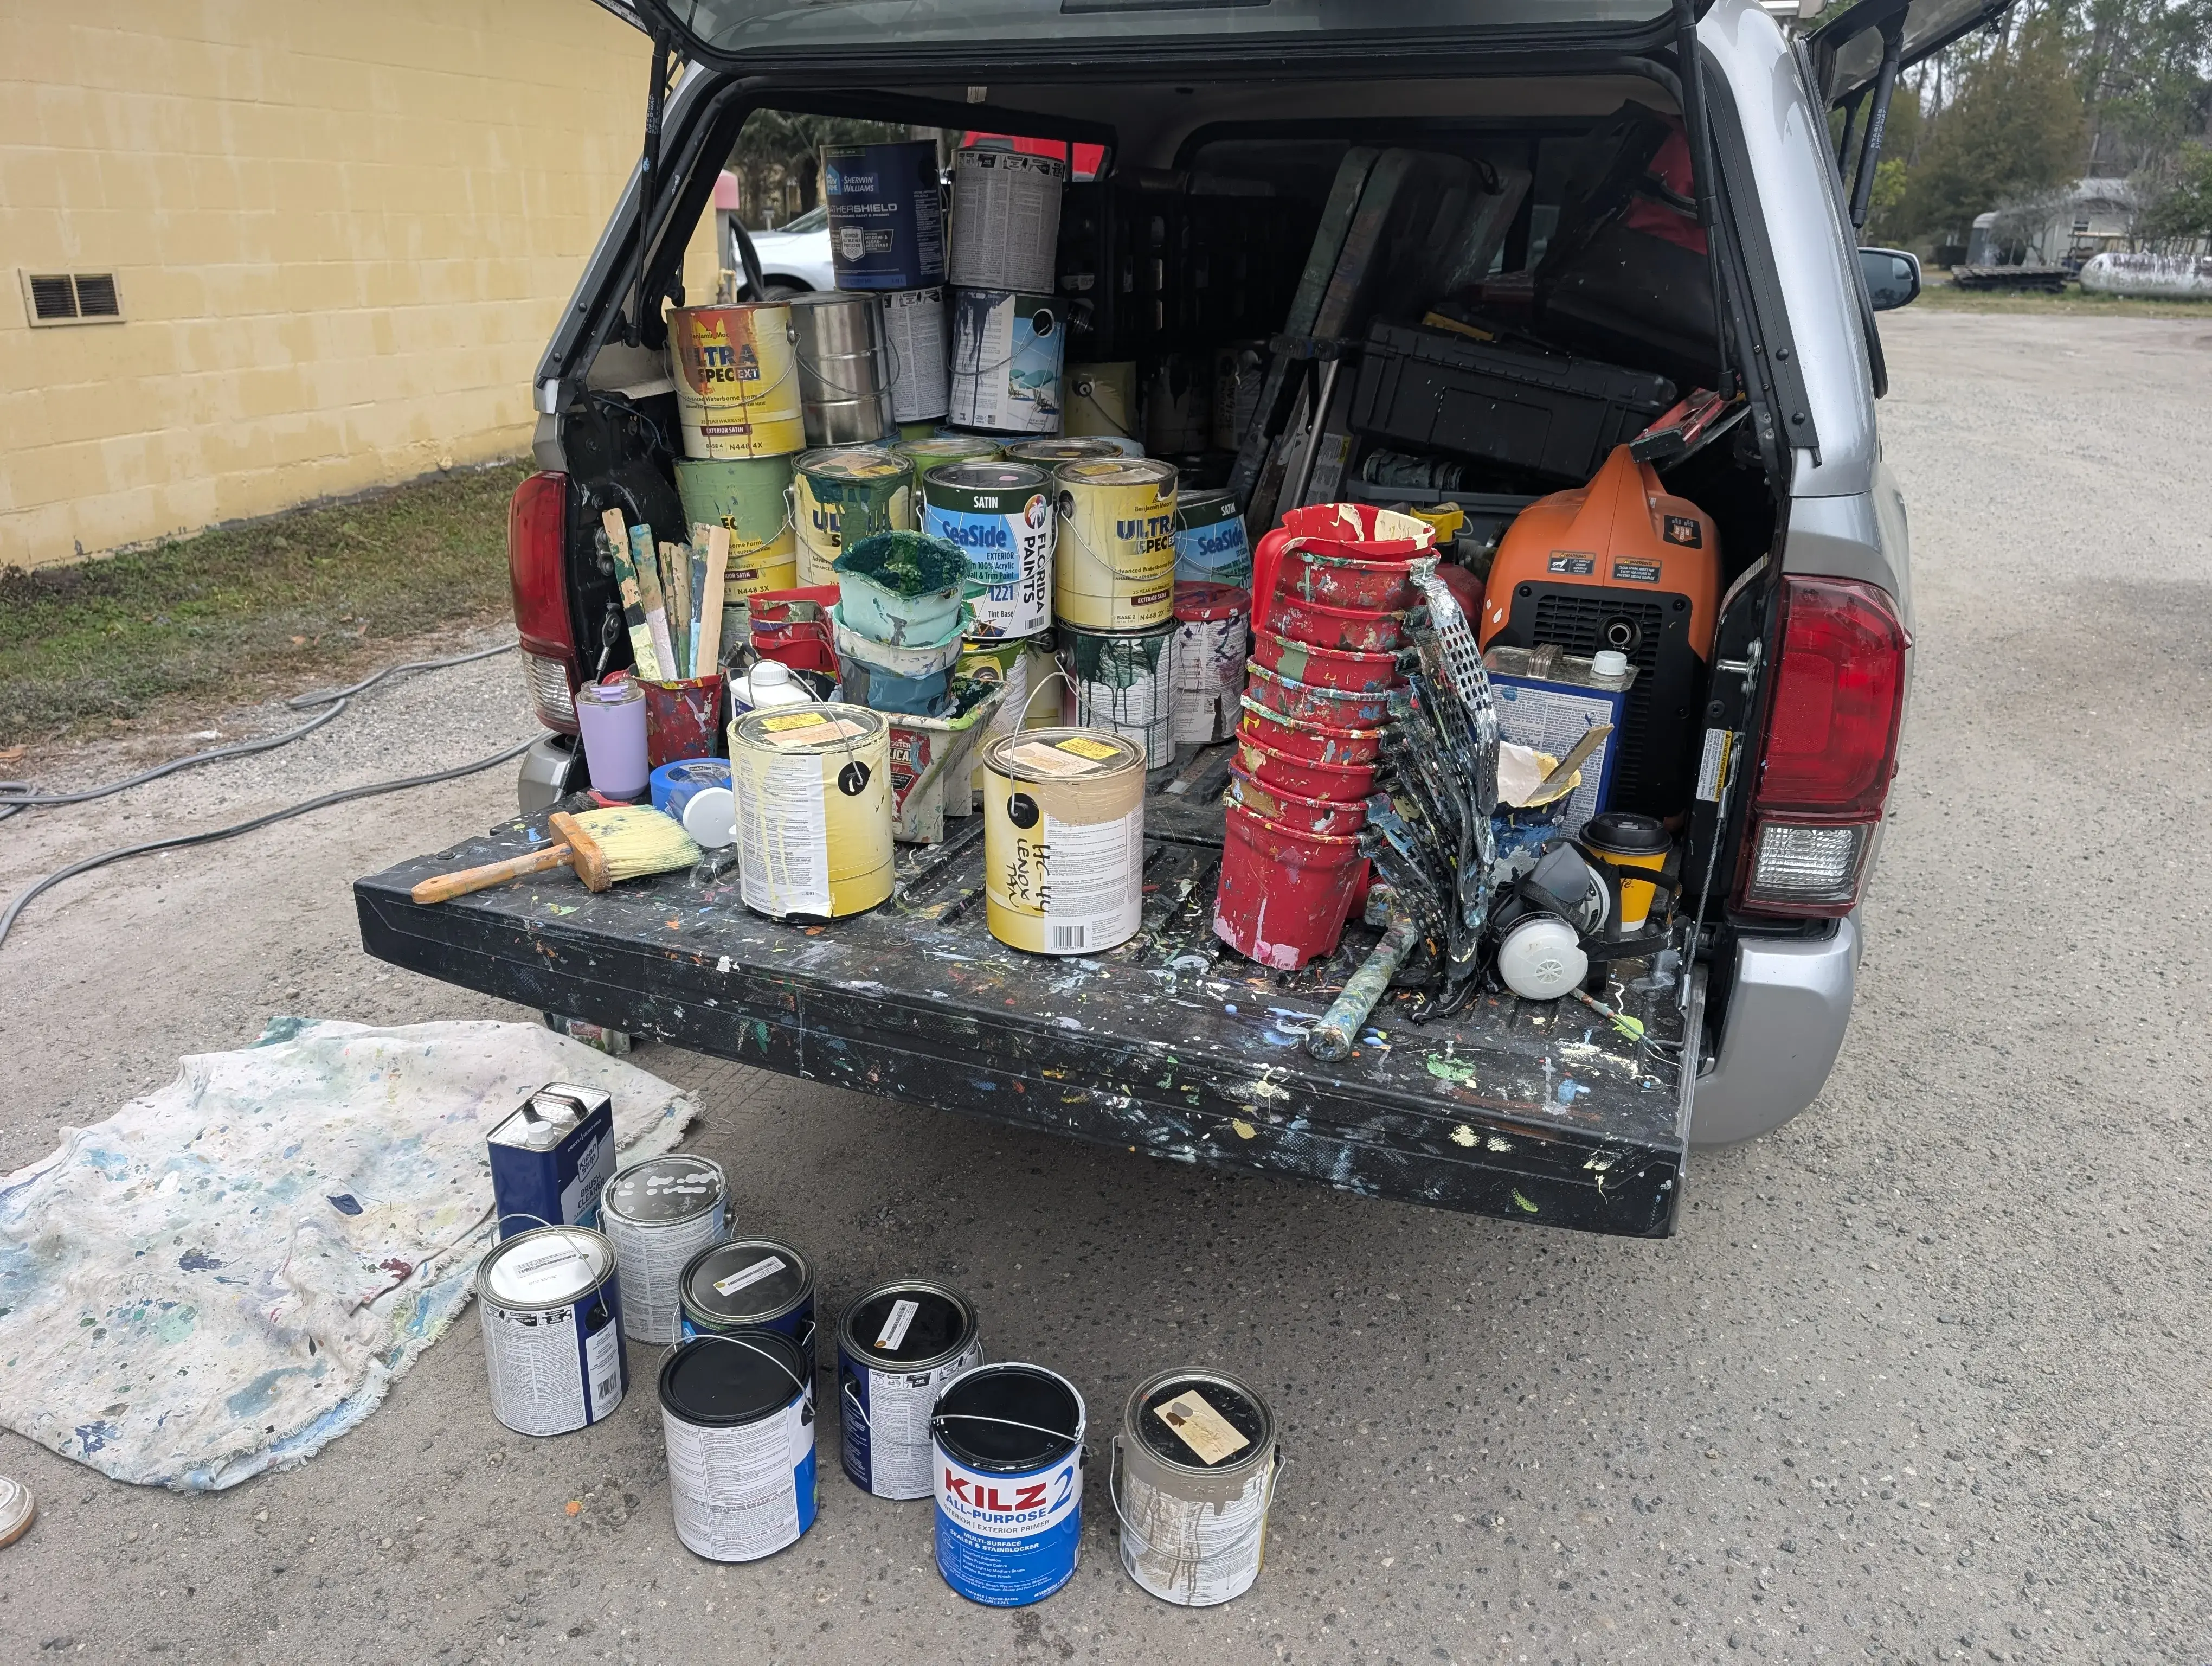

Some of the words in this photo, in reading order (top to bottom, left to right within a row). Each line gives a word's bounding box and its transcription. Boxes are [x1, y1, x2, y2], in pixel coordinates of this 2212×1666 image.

[1871, 108, 1882, 148] STABILUS
[844, 176, 873, 184] SHERWIN
[844, 184, 874, 192] WILLIAMS
[698, 368, 735, 383] SPEC
[737, 368, 758, 379] EXT
[974, 496, 998, 509] SATIN
[1221, 502, 1236, 516] SATIN
[942, 521, 1007, 547] SeaSide
[1197, 527, 1243, 556] SeaSide
[987, 552, 1014, 560] EXTERIOR
[978, 562, 994, 570] 100%
[995, 562, 1014, 571] Acrylic
[1023, 536, 1036, 604] PAINTS
[1036, 533, 1046, 614] FLORIDA
[1142, 562, 1168, 572] Waterborne
[738, 587, 758, 595] N448
[989, 585, 1014, 601] 1221
[1152, 582, 1171, 591] WARRANTY
[1137, 595, 1156, 604] EXTERIOR
[1156, 592, 1167, 601] SATIN
[1140, 613, 1157, 621] N448
[1017, 838, 1030, 900] LENOX
[1006, 862, 1019, 908] TAN
[1032, 844, 1051, 913] HC-44
[568, 1139, 580, 1152] AMERICA'S
[583, 1126, 594, 1137] SOLVENT
[592, 1119, 602, 1129] BRAND
[579, 1143, 597, 1171] Klean
[582, 1154, 595, 1175] Strip
[578, 1177, 606, 1209] CLEANER
[580, 1172, 601, 1199] BRUSH
[573, 1207, 586, 1220] CLEANS
[945, 1466, 1046, 1511] KILZ
[1047, 1465, 1073, 1514] 2
[946, 1494, 1046, 1524] ALL-PURPOSE
[943, 1502, 971, 1526] INTERIOR
[978, 1523, 1018, 1534] EXTERIOR
[1020, 1519, 1050, 1533] PRIMER
[950, 1529, 973, 1546] SEALER
[982, 1543, 1039, 1553] STAINBLOCKER
[963, 1532, 1021, 1547] MULTI-SURFACE
[962, 1548, 980, 1559] Excellent
[962, 1554, 974, 1562] Hides
[974, 1557, 992, 1567] Previous
[962, 1559, 975, 1567] Blocks
[962, 1564, 977, 1573] Mildew
[965, 1588, 985, 1598] TINTABLE
